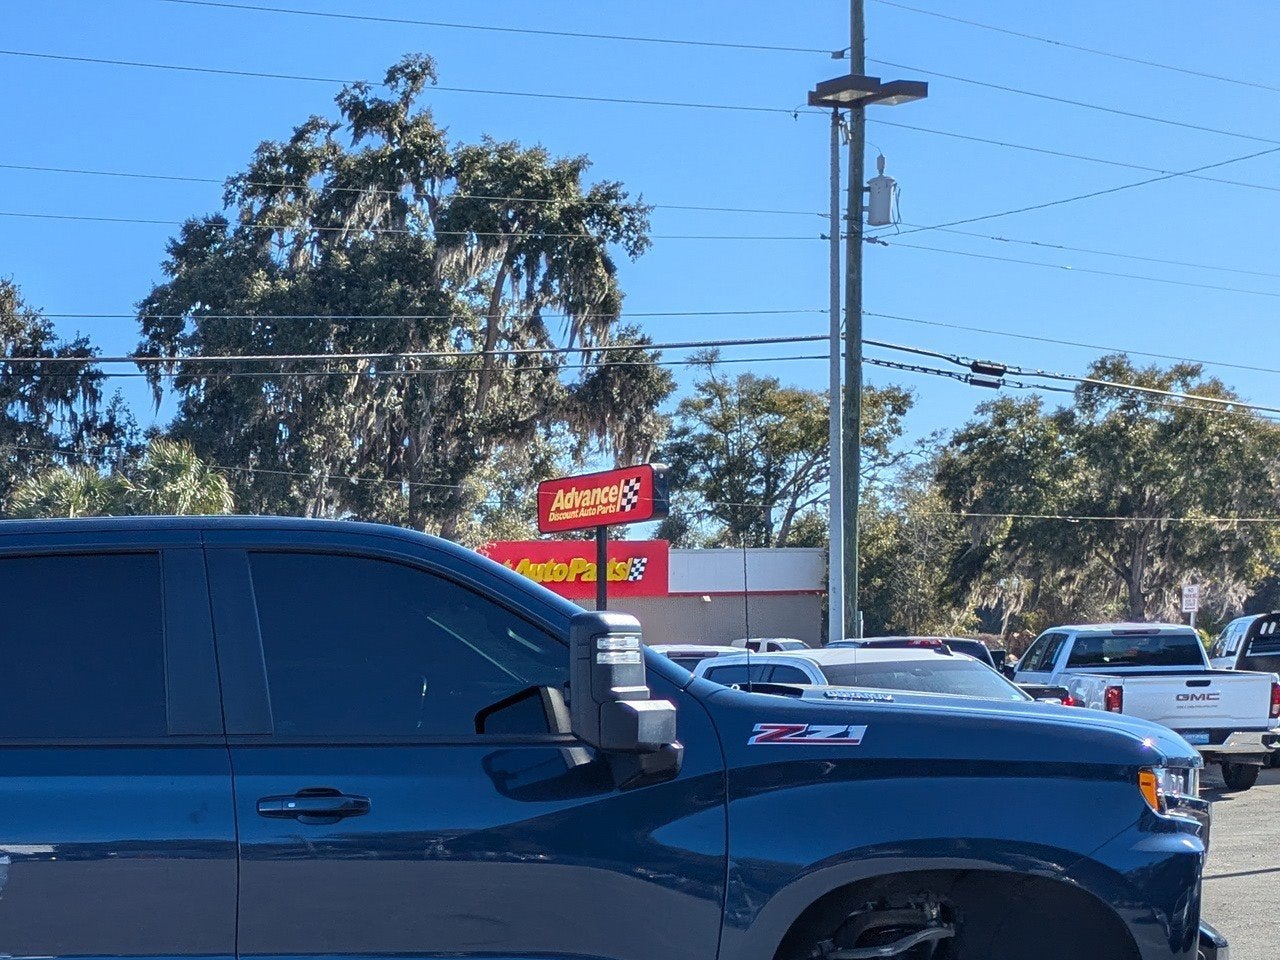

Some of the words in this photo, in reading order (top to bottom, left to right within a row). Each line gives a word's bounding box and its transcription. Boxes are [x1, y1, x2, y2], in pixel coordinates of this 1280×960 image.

[551, 484, 619, 512] Advance
[549, 508, 580, 522] Discount
[580, 506, 597, 518] Auto
[597, 504, 617, 515] Parts
[567, 557, 627, 582] Pats
[1176, 693, 1220, 702] GMC
[747, 723, 868, 746] Z71
